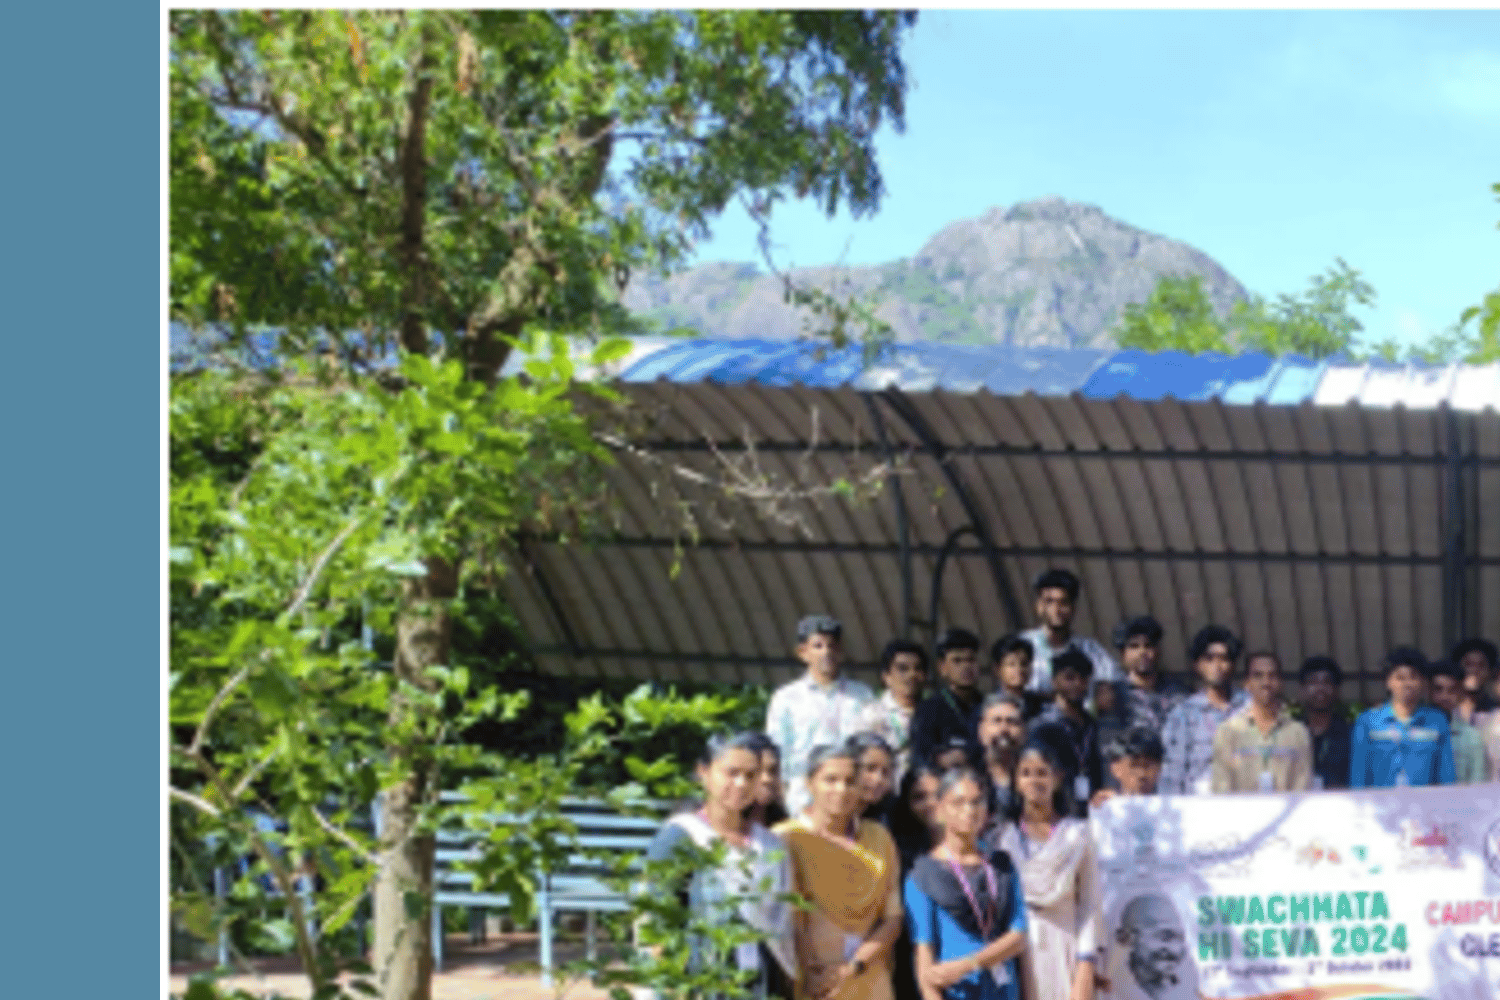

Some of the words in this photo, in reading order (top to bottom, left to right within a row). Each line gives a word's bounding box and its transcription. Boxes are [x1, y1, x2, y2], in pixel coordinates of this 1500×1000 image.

[1198, 890, 1389, 927] SWACHHATA
[1198, 928, 1231, 961] HI
[1243, 926, 1320, 959] SEVA
[1331, 922, 1408, 956] 2024
